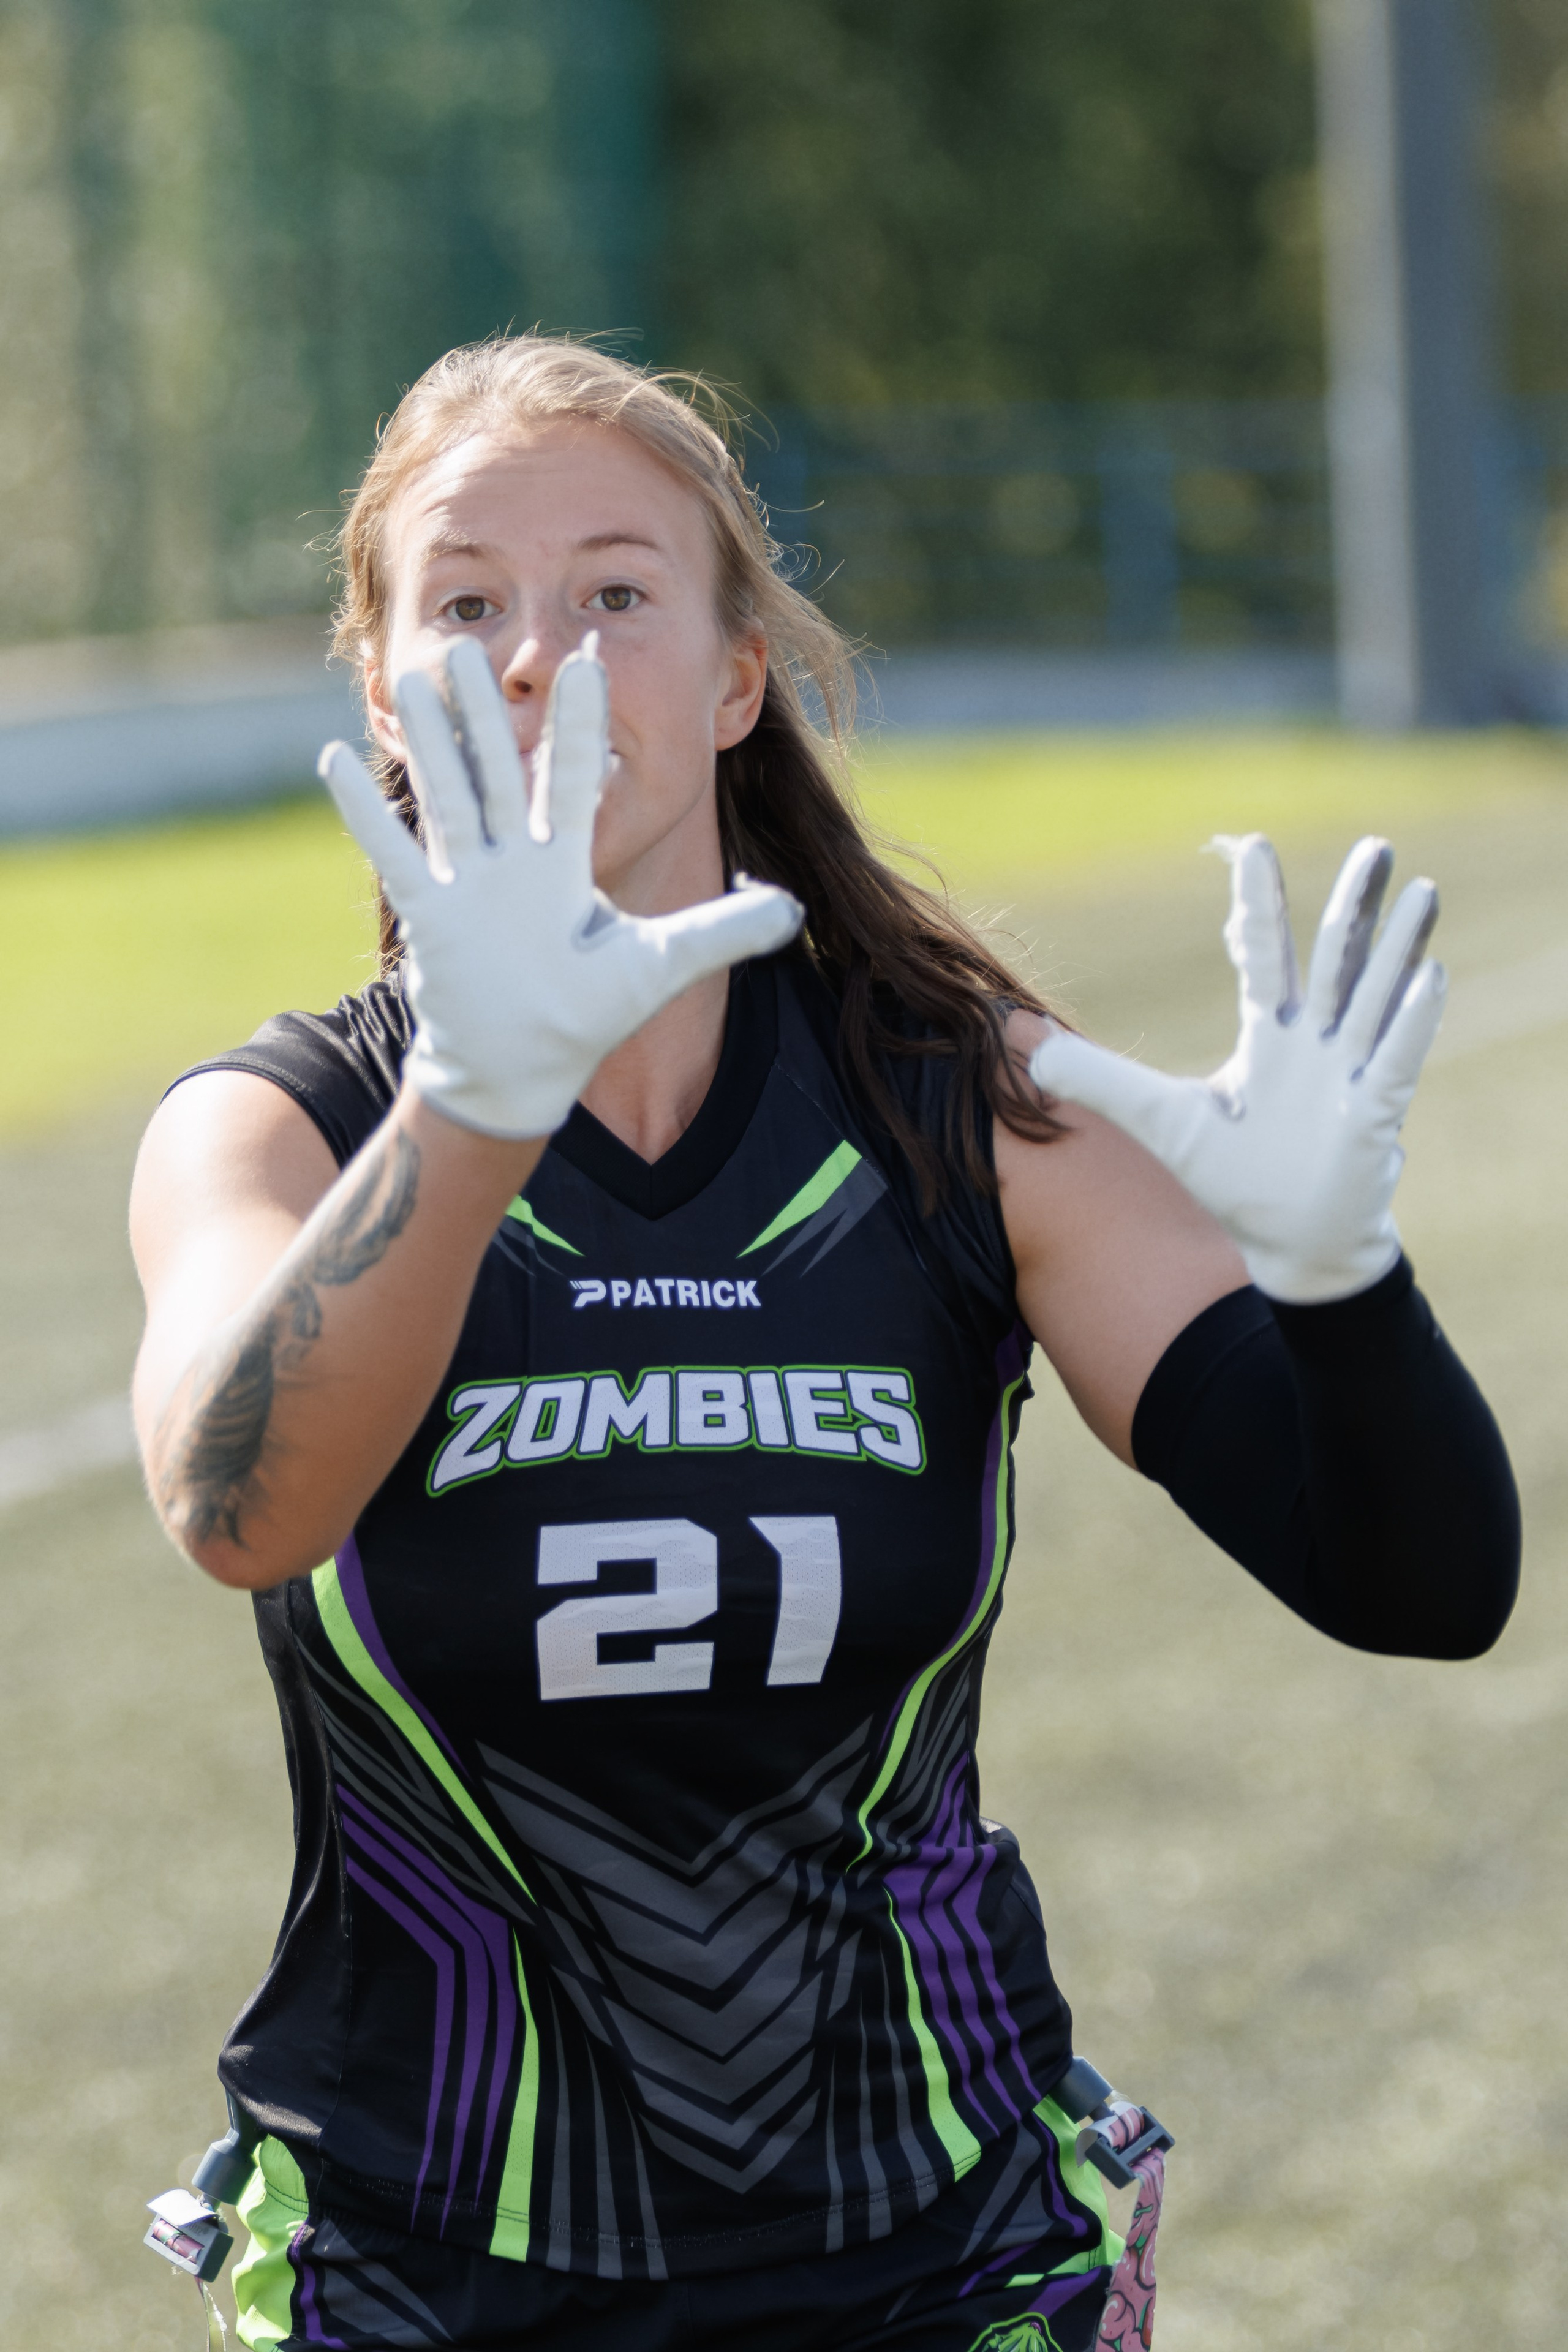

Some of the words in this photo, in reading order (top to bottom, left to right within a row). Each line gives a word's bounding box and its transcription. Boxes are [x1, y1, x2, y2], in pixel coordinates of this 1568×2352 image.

[611, 1278, 761, 1307] PATRICK
[427, 1365, 927, 1497] ZOMBIES
[537, 1515, 842, 1701] 21
